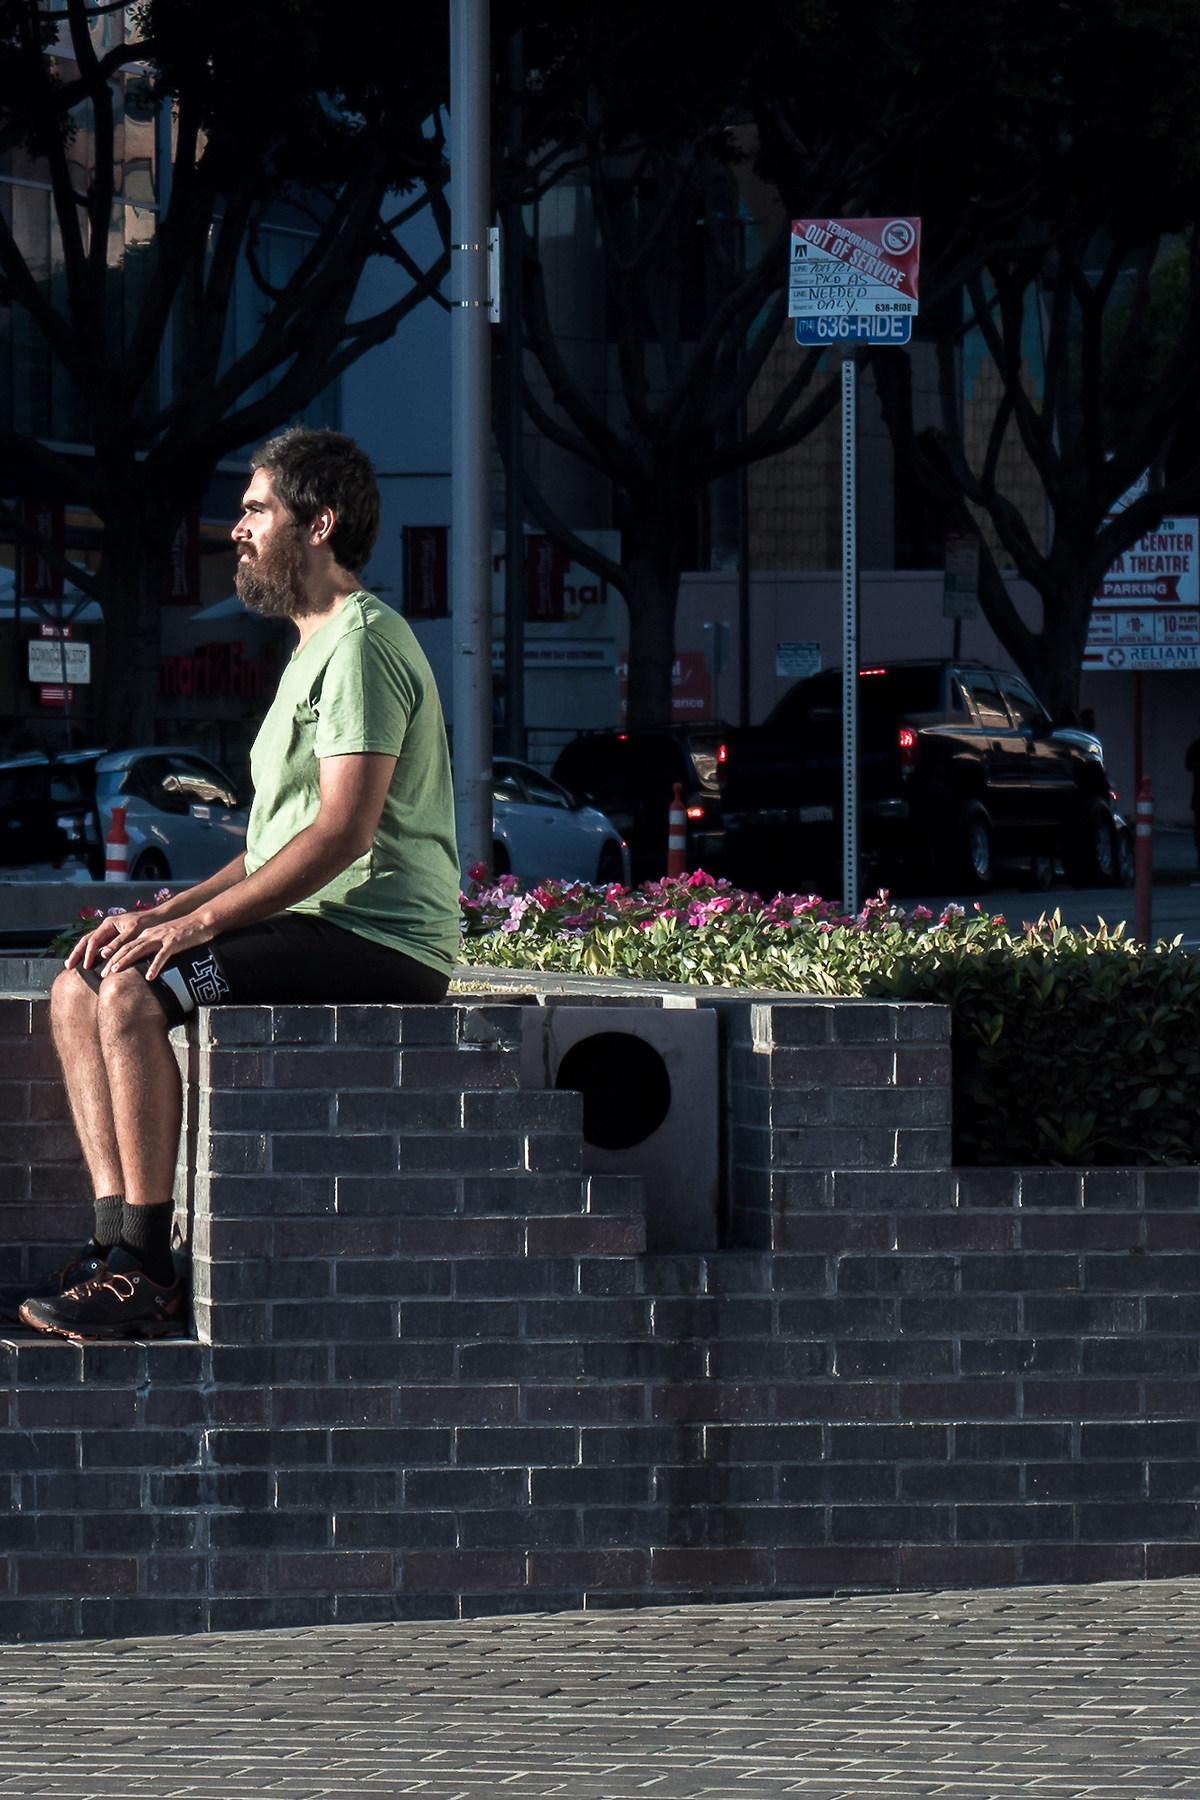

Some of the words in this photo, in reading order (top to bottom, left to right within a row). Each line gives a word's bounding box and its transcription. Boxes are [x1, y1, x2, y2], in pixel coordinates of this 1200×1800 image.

[826, 220, 884, 257] TEMPORARILY
[804, 224, 833, 249] OUT
[831, 238, 850, 258] OF
[849, 247, 906, 289] SERVICE
[809, 286, 867, 300] NEEDED
[875, 303, 912, 312] 636-RIDE
[817, 316, 904, 337] 636-RIDE
[1141, 534, 1193, 552] CENTER
[1130, 556, 1190, 573] THEATRE
[1104, 583, 1168, 595] PARKING
[1130, 647, 1198, 660] RELIANT
[1131, 661, 1168, 669] URGENT
